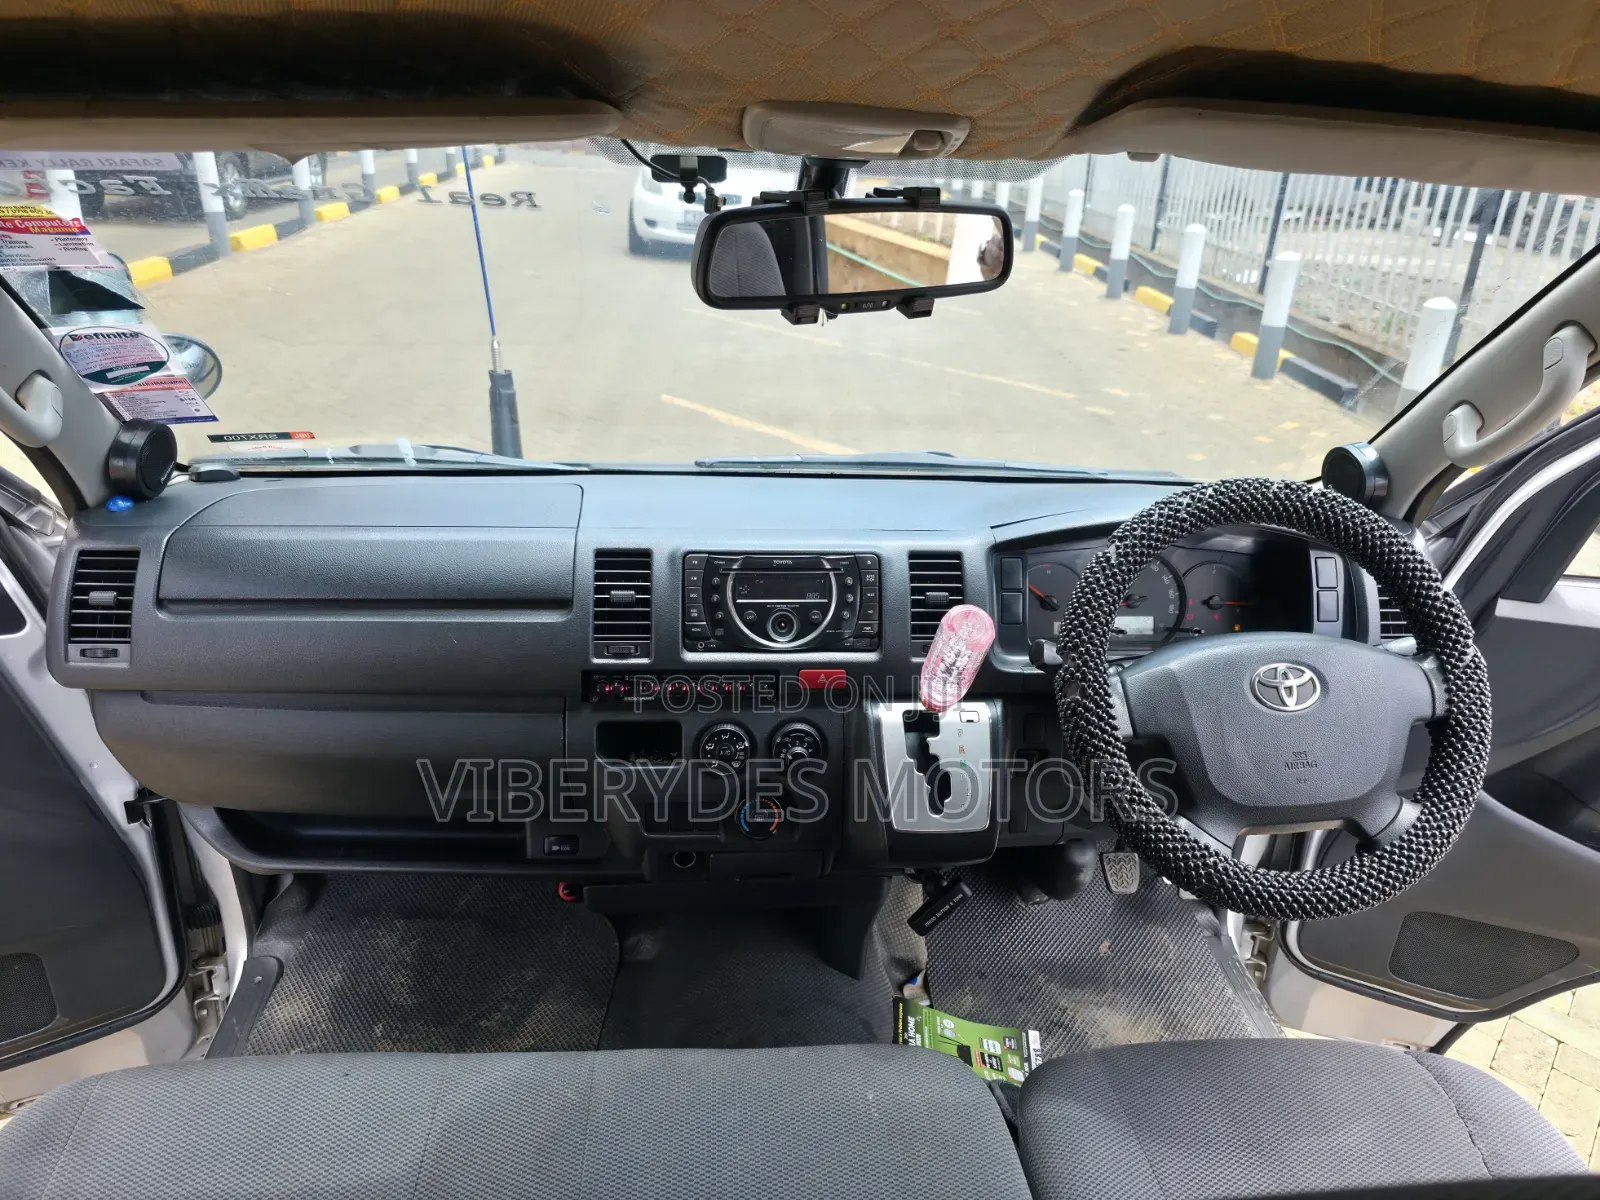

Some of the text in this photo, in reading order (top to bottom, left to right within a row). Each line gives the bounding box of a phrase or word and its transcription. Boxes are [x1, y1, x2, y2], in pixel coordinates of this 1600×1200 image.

[14, 219, 81, 229] Computers
[68, 331, 140, 342] Definite
[957, 728, 964, 738] P
[1283, 760, 1318, 771] AIRBAG
[907, 1015, 915, 1038] HOME
